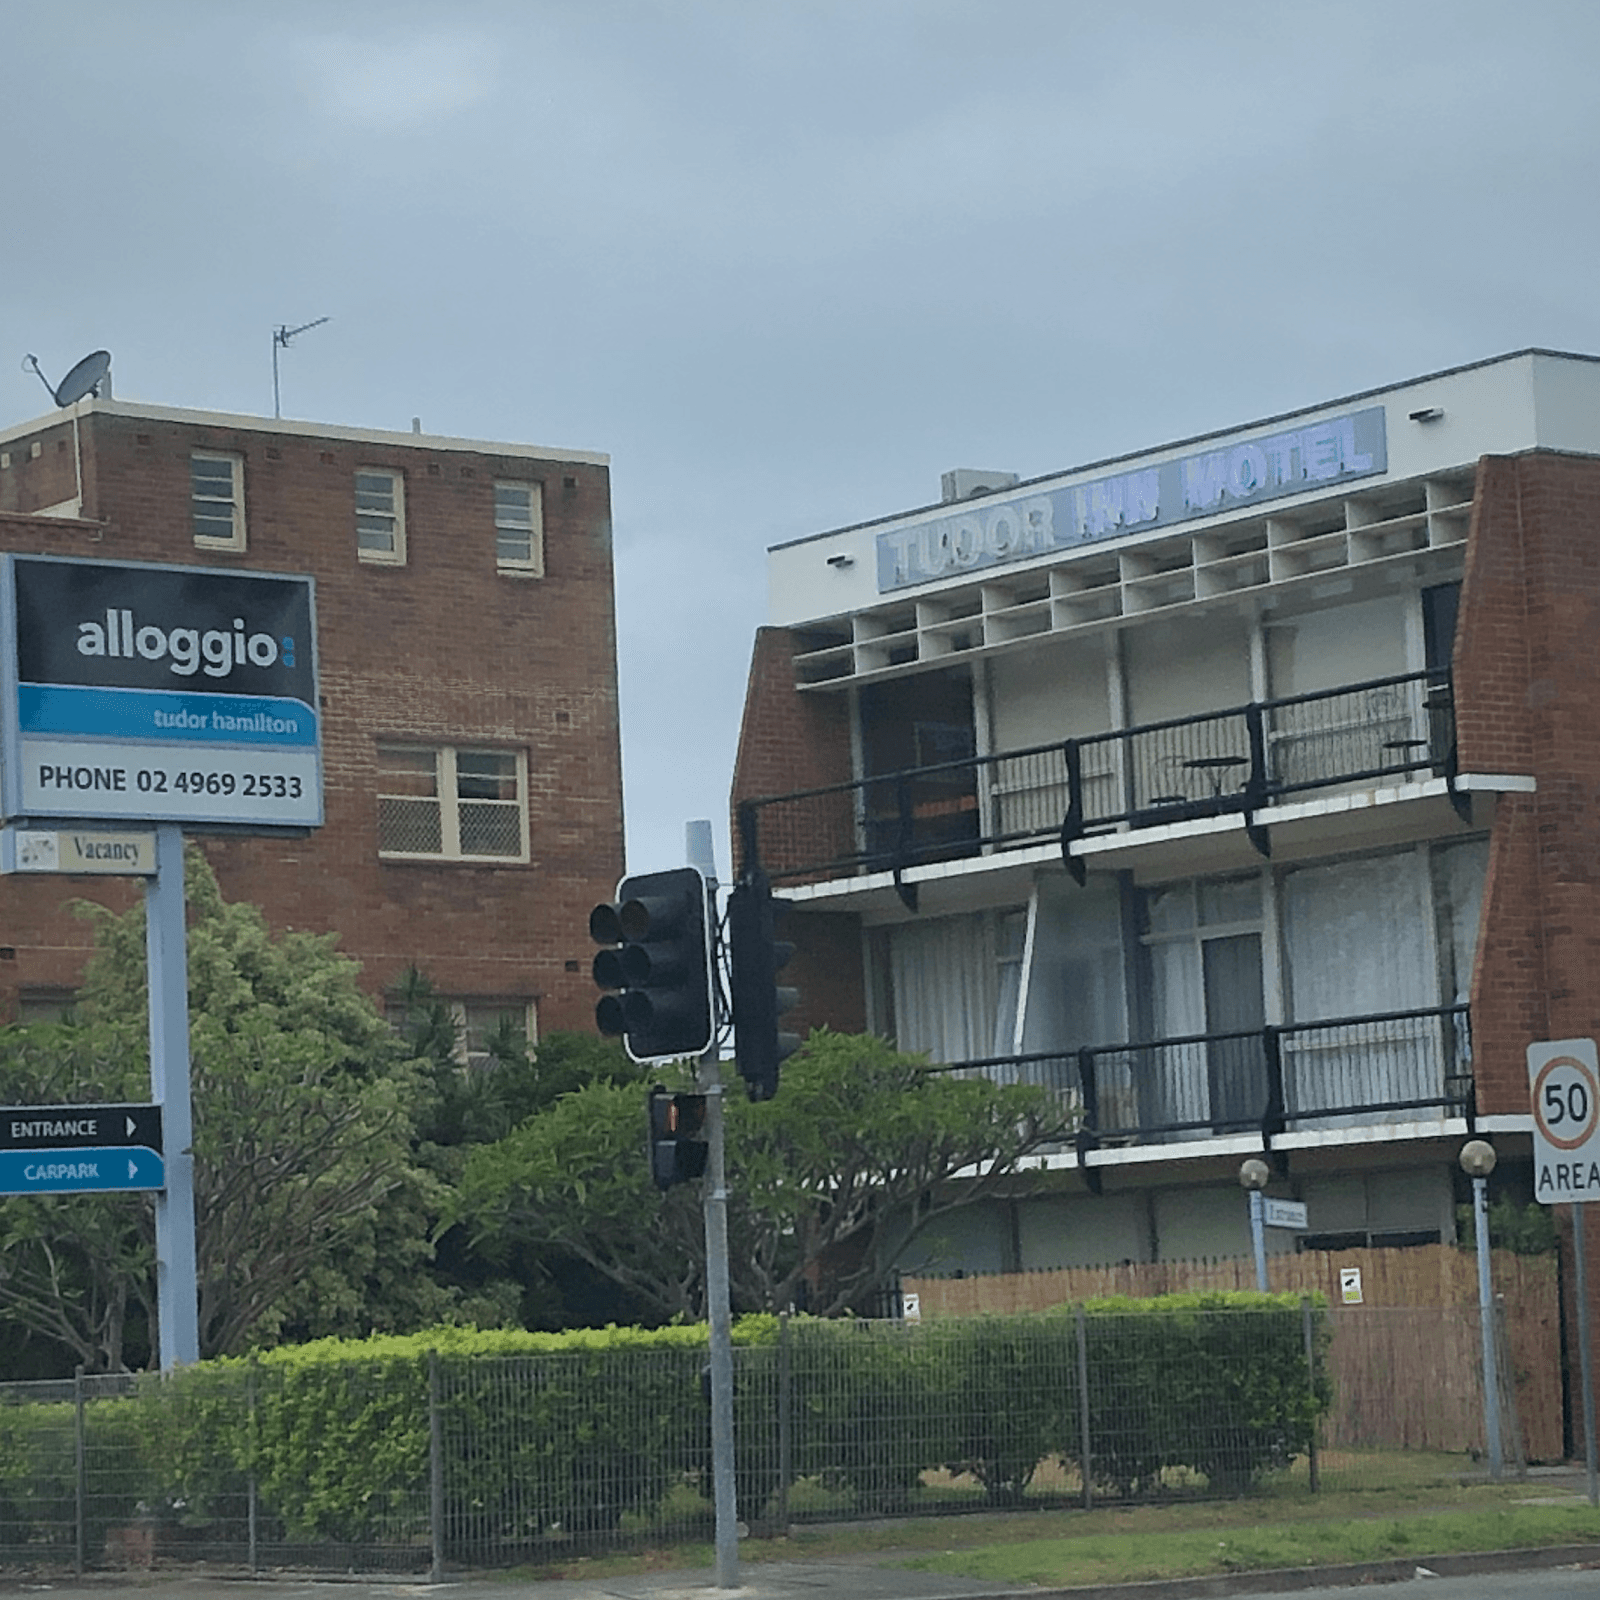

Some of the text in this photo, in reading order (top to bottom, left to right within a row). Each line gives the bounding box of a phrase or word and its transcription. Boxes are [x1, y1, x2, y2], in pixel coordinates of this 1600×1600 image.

[885, 418, 1372, 583] TUDOR INN MOTEL
[153, 709, 298, 734] tudor hamilton
[39, 765, 303, 799] PHONE 02 4969 2533
[73, 836, 140, 867] Vacancy
[1546, 1083, 1587, 1124] 50
[11, 1120, 97, 1138] ENTRANCE
[23, 1163, 99, 1180] CARPARK
[1539, 1162, 1600, 1191] AREA
